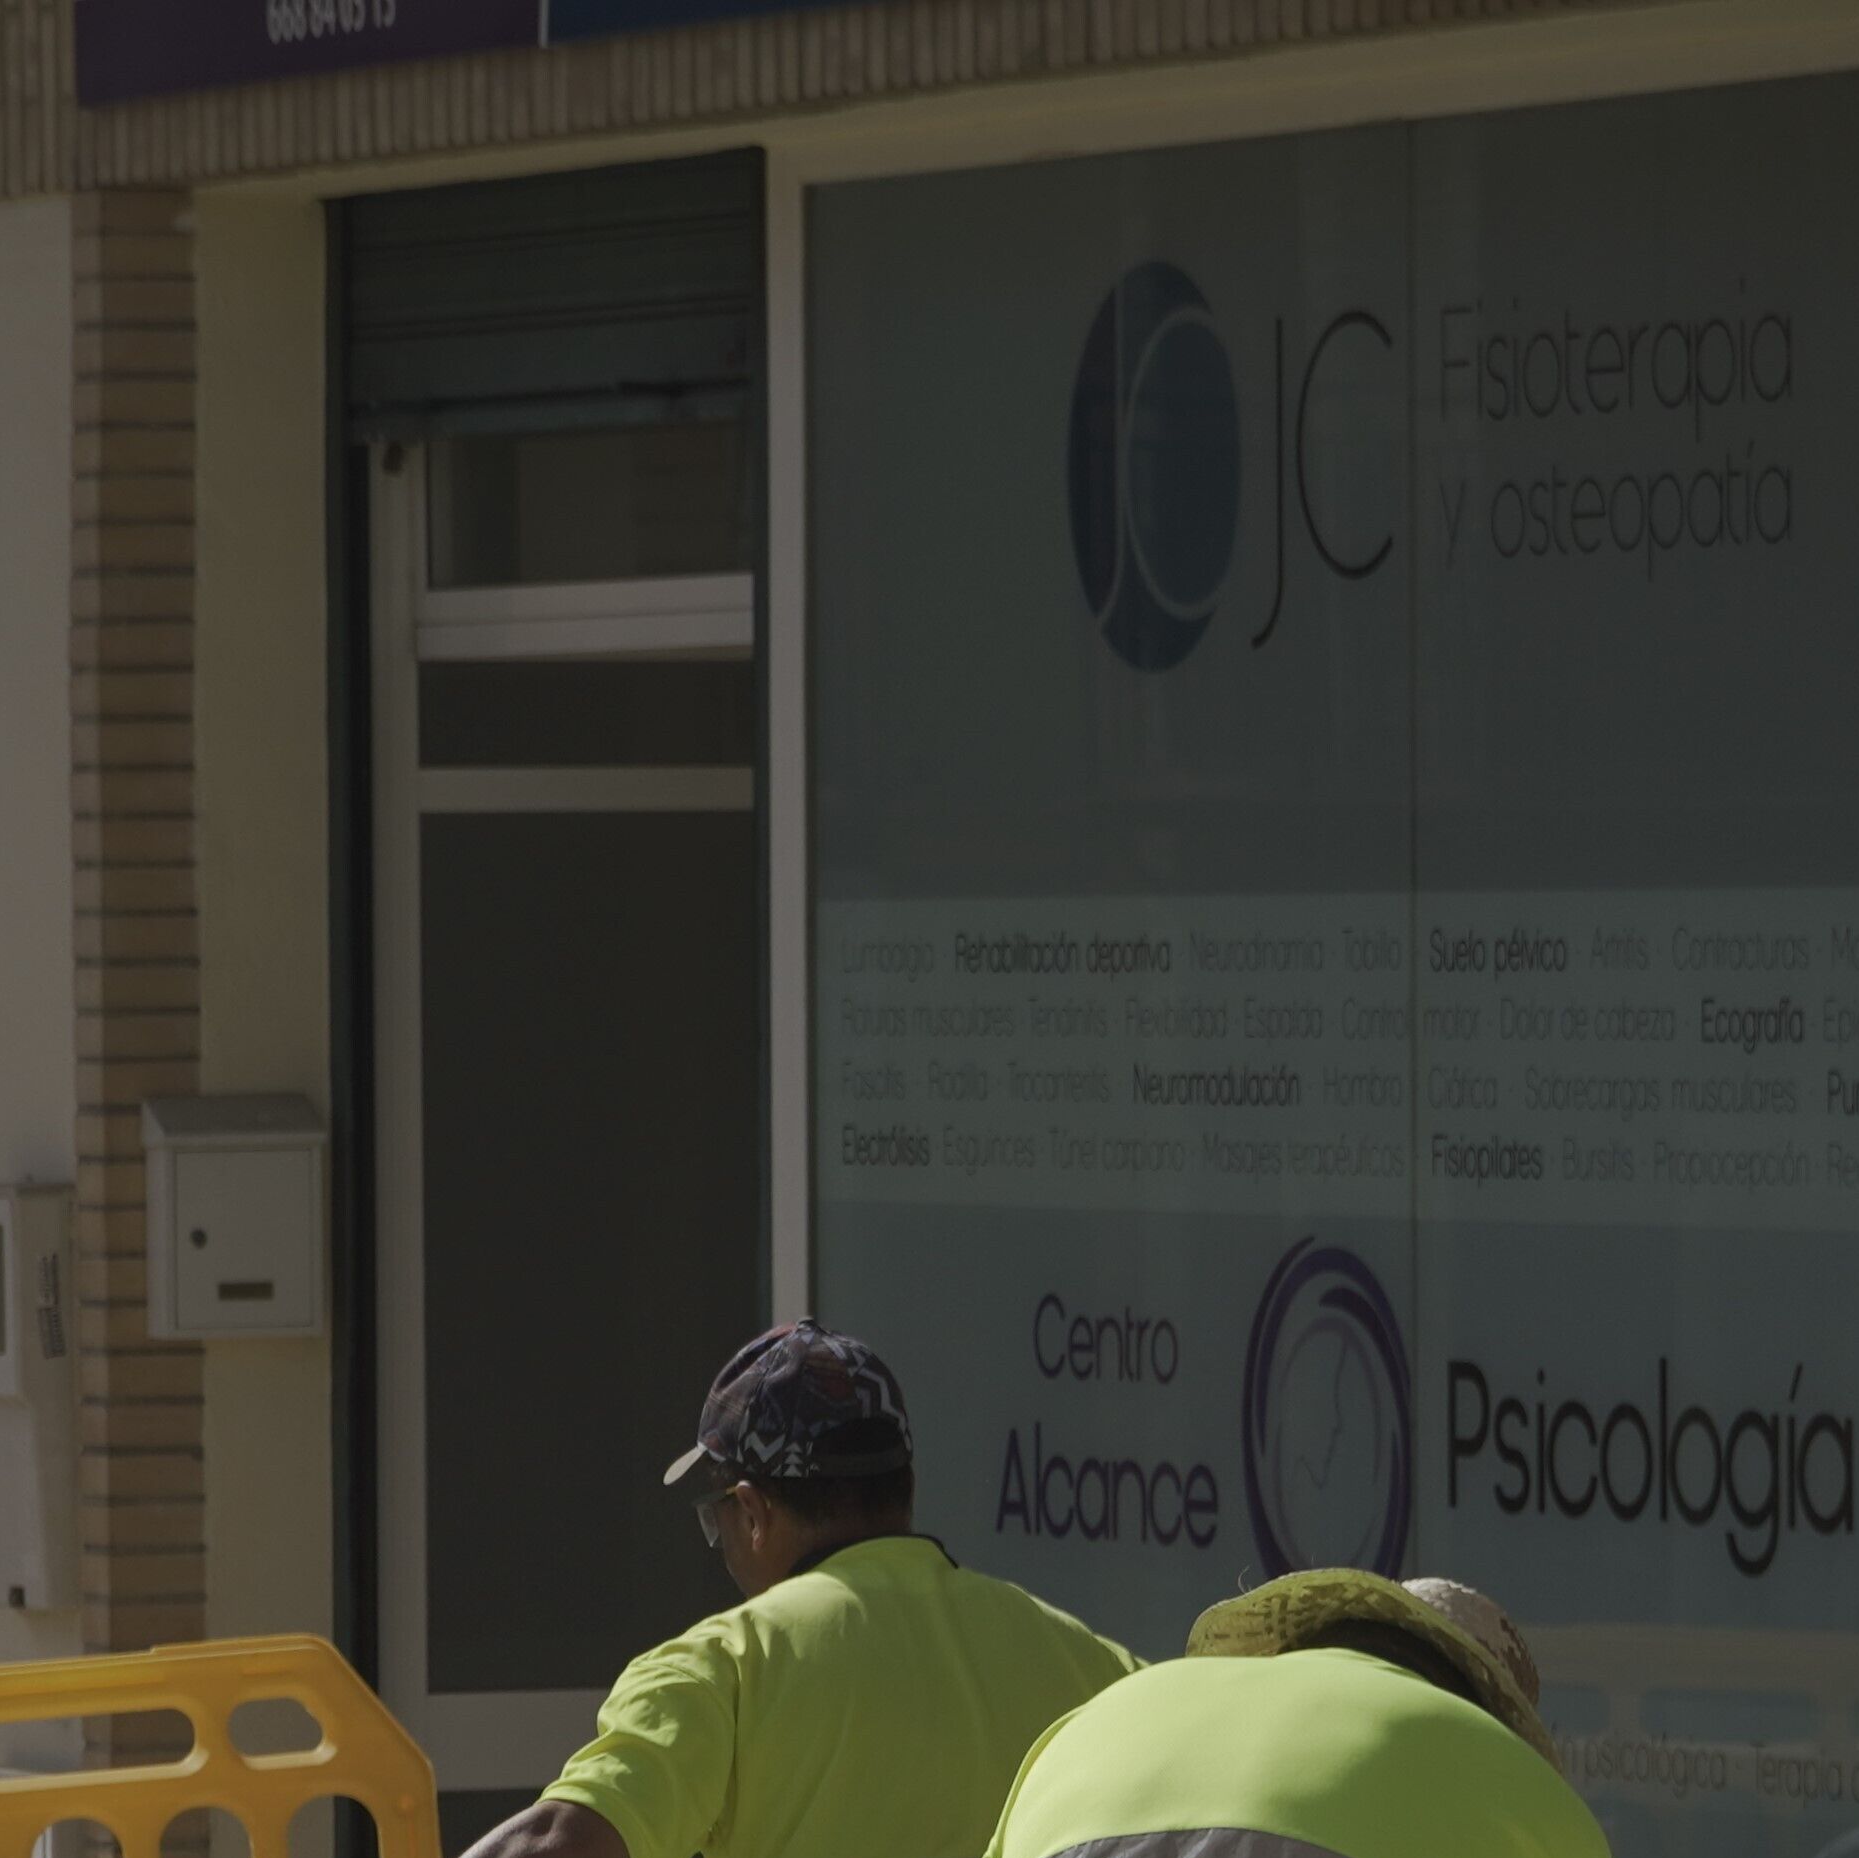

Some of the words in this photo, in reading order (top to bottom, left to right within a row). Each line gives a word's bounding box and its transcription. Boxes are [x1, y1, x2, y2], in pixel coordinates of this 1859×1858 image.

[1440, 297, 1793, 442] Fisioterapia
[1250, 310, 1395, 650] JC
[1490, 440, 1793, 582] osteopatía
[953, 929, 1080, 974] Rehabilitación
[1085, 928, 1171, 982] deportiva
[1429, 926, 1487, 972] Suelo
[1493, 926, 1567, 983] pélvico
[1671, 925, 1809, 972] Contracturas
[1559, 998, 1588, 1041] de
[1699, 995, 1804, 1055] Ecografía
[1131, 1060, 1302, 1107] Neuromodulación
[1431, 1133, 1544, 1188] Fisiopilates
[1033, 1293, 1179, 1386] Centro
[994, 1422, 1220, 1548] Alcance
[1447, 1357, 1855, 1579] Psicología
